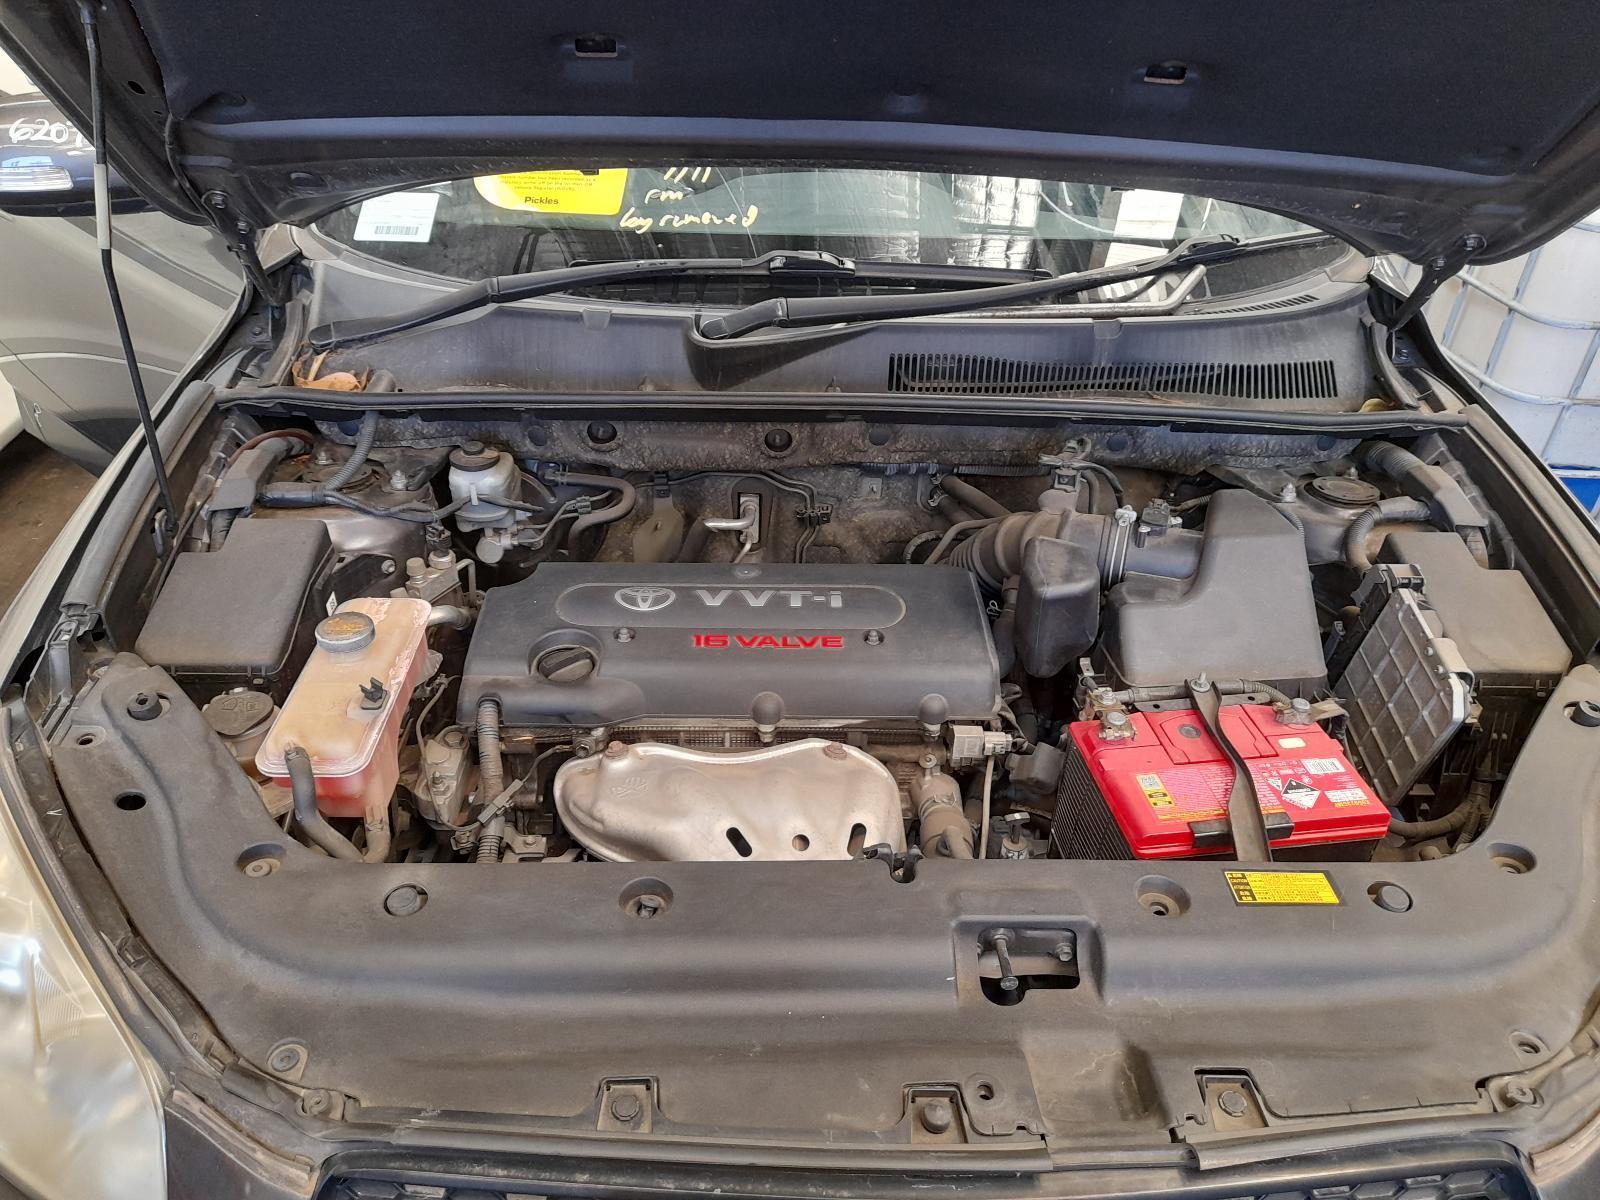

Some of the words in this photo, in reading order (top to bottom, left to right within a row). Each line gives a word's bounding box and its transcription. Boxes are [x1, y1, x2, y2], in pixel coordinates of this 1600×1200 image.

[524, 195, 559, 205] Pickles
[695, 589, 843, 608] VVT-i
[692, 633, 731, 649] 16
[734, 634, 845, 649] VALVE
